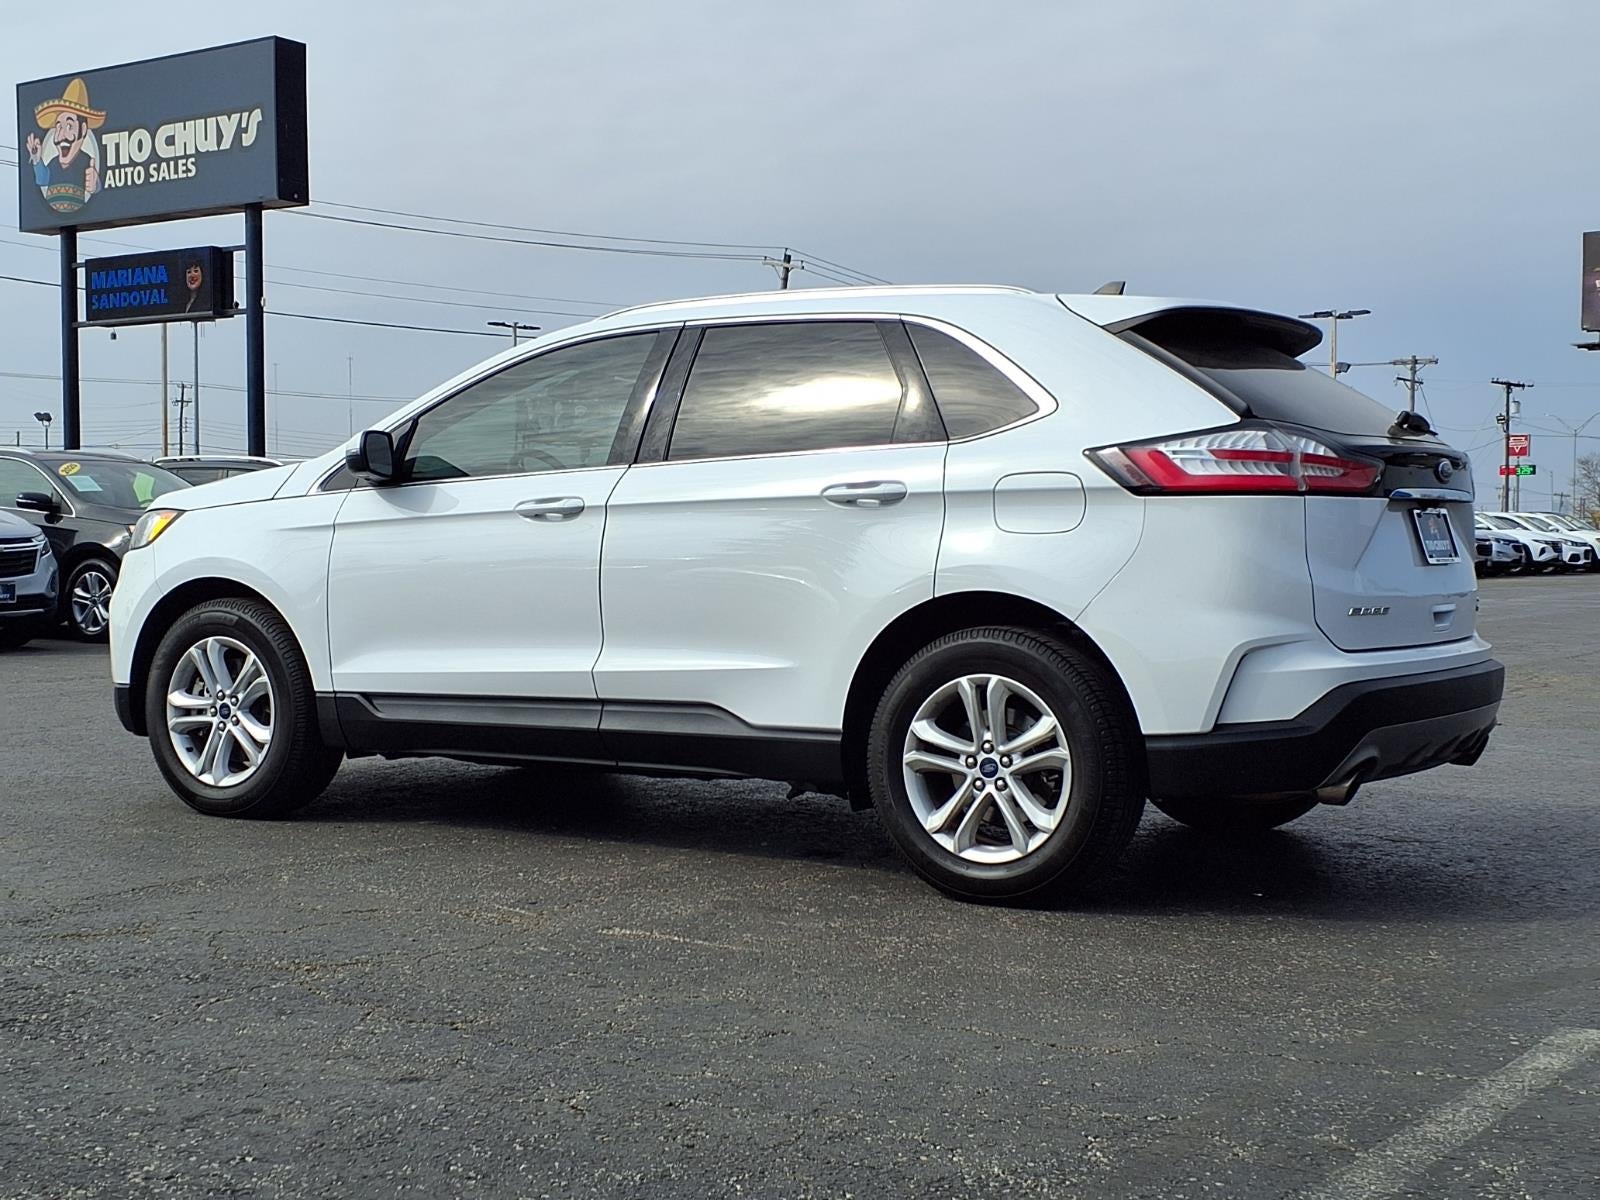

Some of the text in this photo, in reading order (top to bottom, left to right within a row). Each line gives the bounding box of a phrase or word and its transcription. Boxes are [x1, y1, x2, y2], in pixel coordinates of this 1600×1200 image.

[102, 108, 263, 167] TIO CHUY'S
[104, 157, 197, 189] AUTO SALES
[91, 264, 169, 290] MARIANA
[91, 288, 169, 310] SANDOVAL
